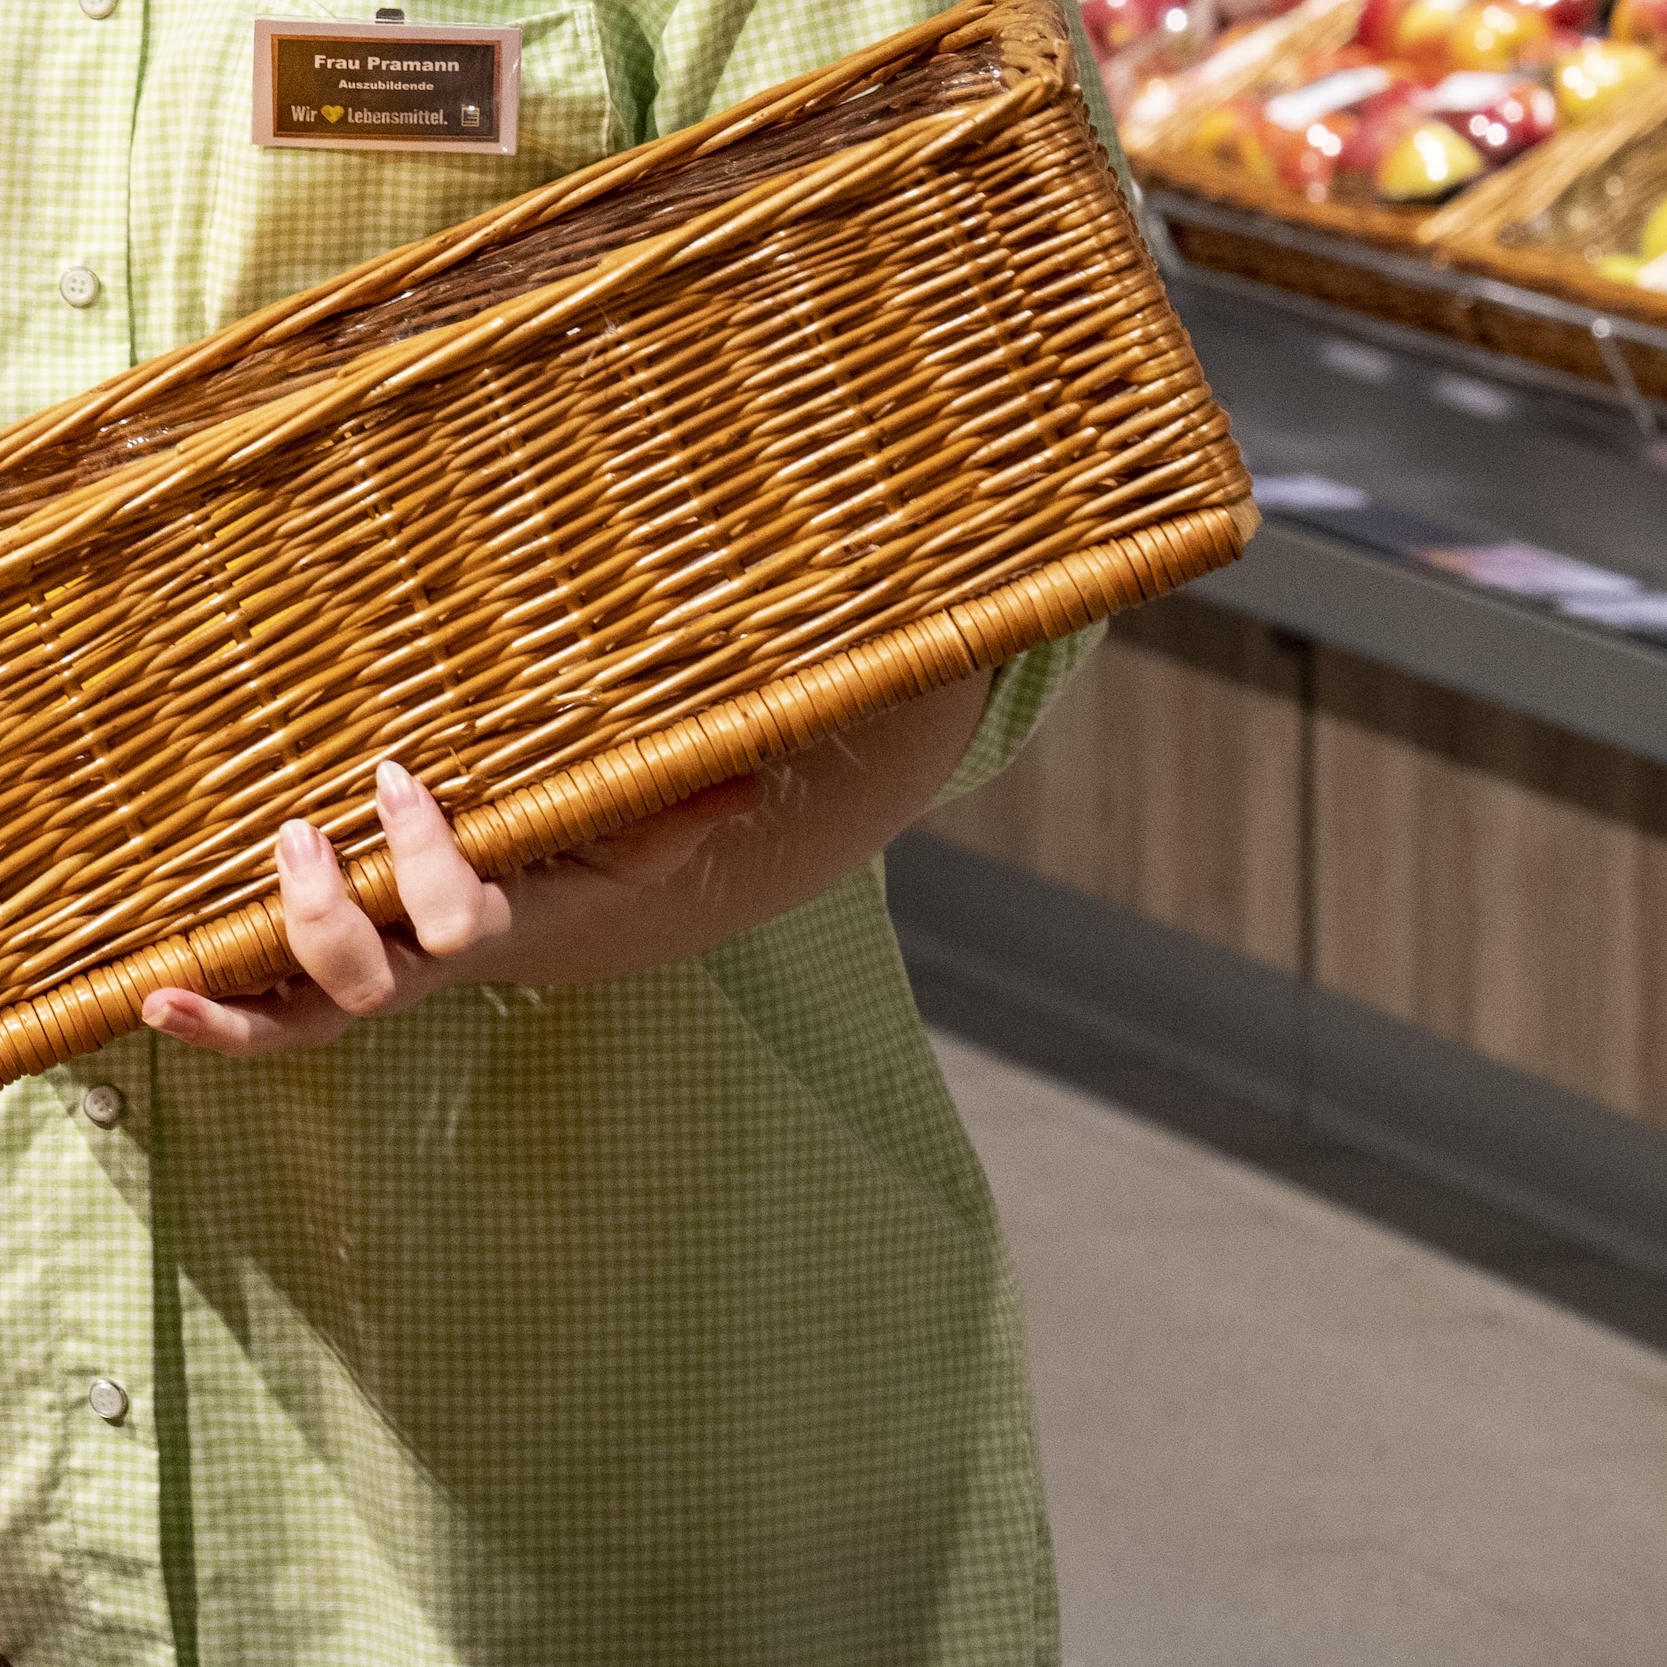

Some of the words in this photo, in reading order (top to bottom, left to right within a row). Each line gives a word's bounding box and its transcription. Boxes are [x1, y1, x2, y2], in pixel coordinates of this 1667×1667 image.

[314, 54, 361, 71] Frau
[367, 55, 461, 73] Pramann
[338, 78, 435, 92] Auszubildende
[291, 104, 318, 124] Wir
[347, 107, 449, 127] Lebensmittel.
